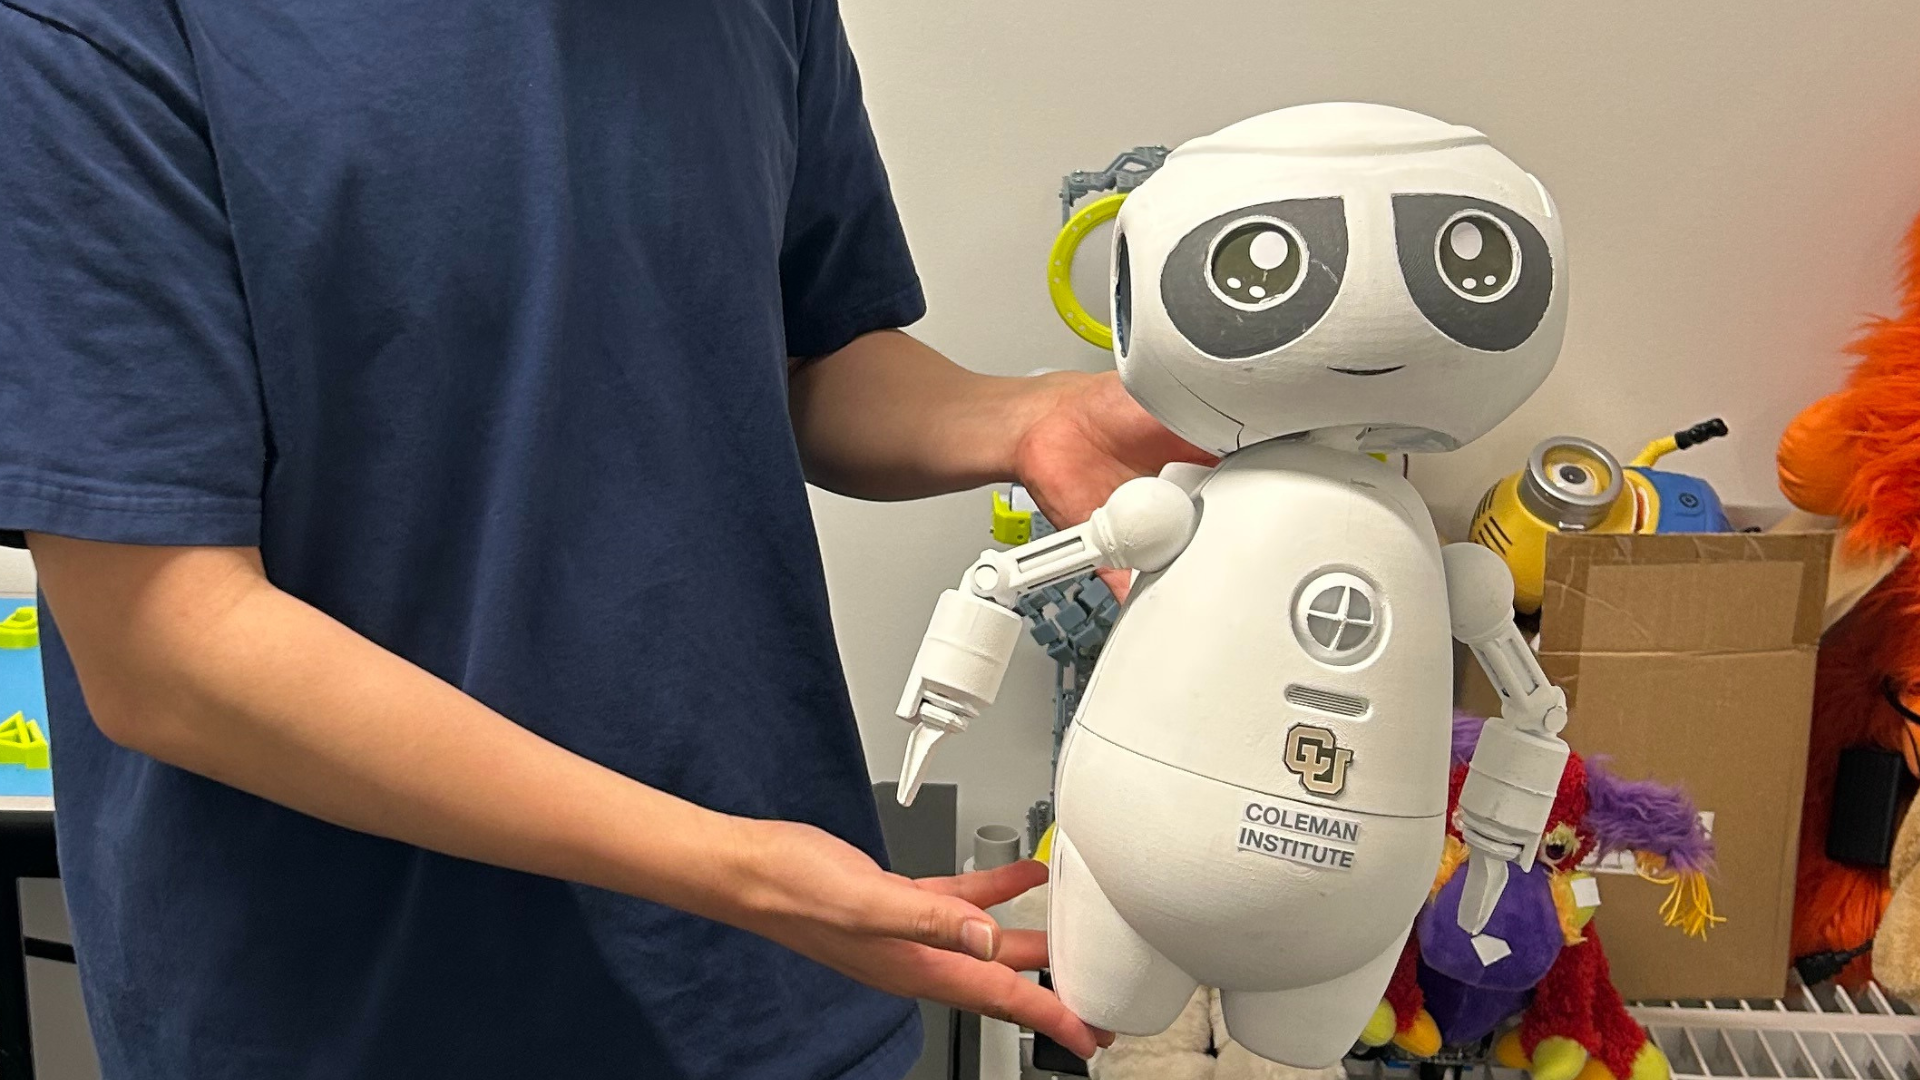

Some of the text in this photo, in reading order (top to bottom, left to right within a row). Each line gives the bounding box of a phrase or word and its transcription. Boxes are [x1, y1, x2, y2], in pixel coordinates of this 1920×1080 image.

[1284, 725, 1353, 795] CU
[1245, 803, 1358, 841] COLEMAN
[1239, 827, 1354, 868] INSTITUTE
